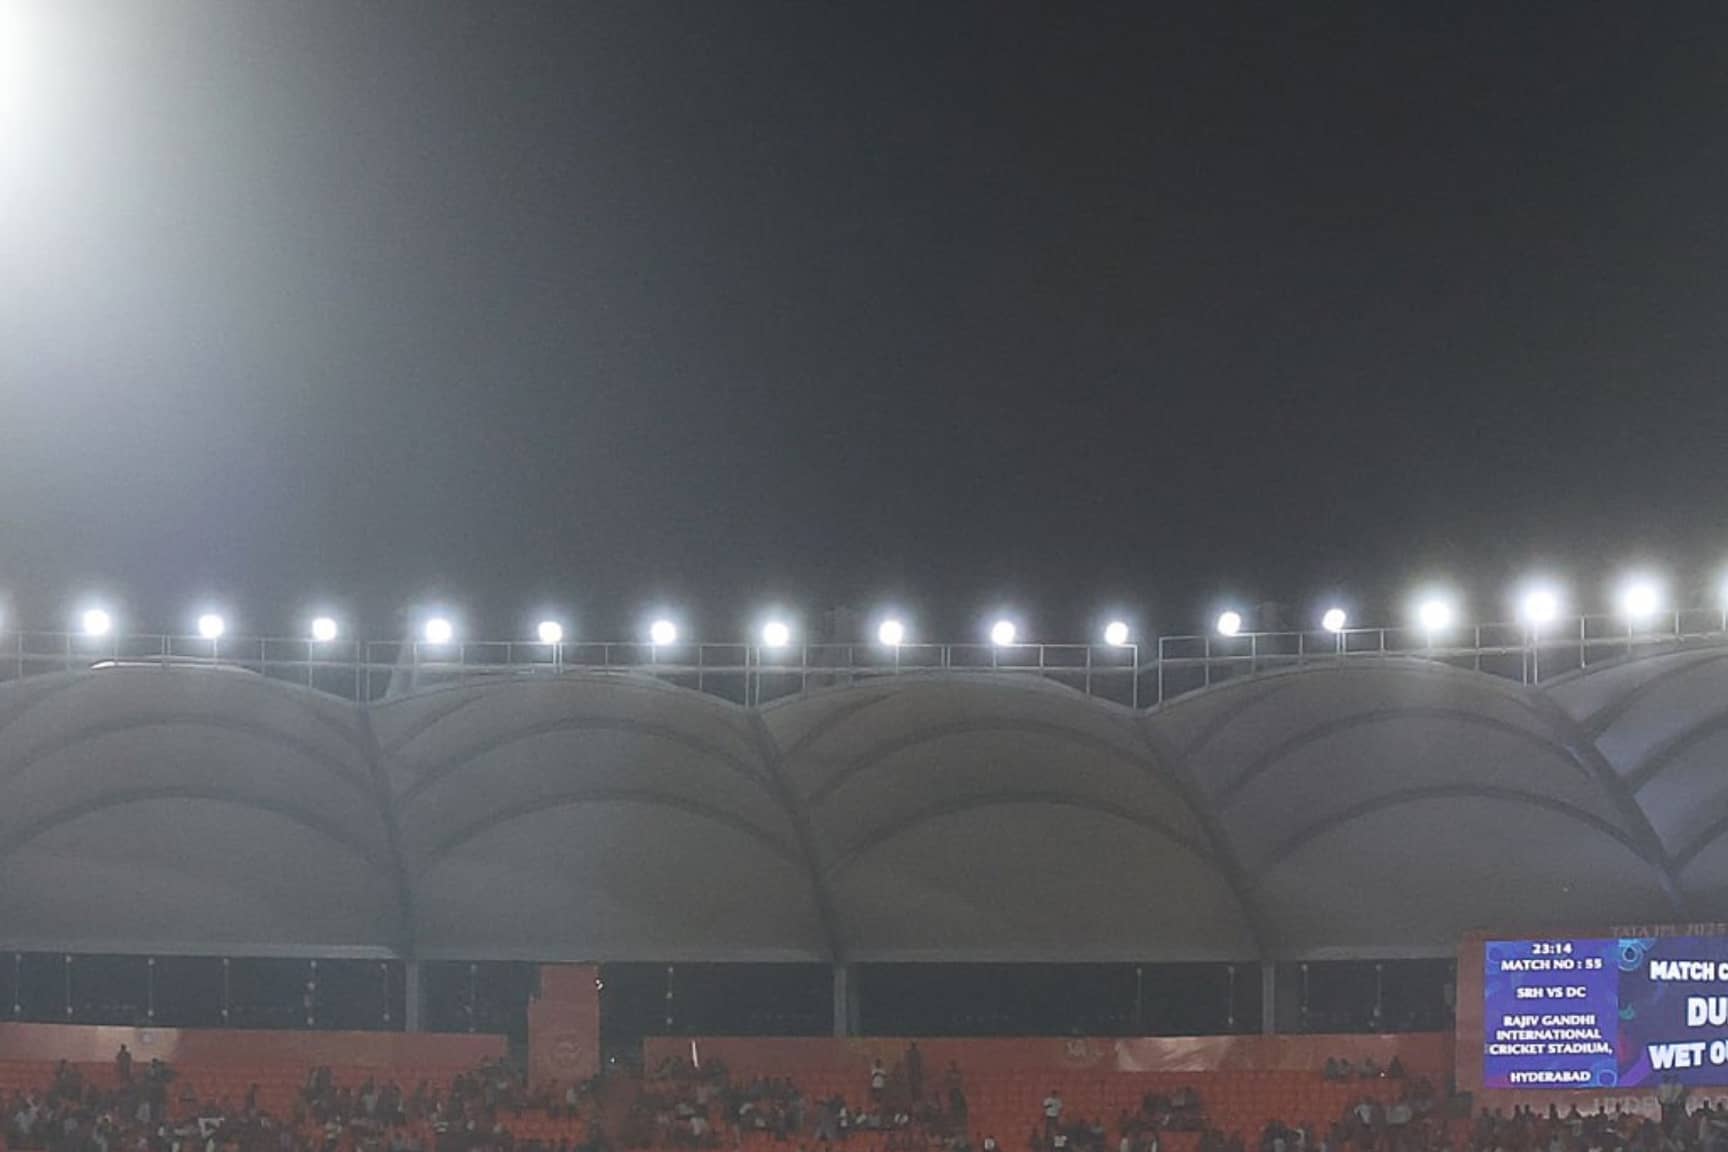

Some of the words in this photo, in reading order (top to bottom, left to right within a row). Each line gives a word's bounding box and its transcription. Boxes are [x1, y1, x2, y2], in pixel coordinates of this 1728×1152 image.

[1532, 943, 1572, 955] 23:14
[1501, 959, 1550, 971] MATCH
[1553, 959, 1575, 970] NO
[1585, 958, 1603, 970] 55
[1649, 960, 1715, 981] MATCH
[1516, 987, 1543, 999] SRH
[1546, 987, 1563, 998] VS
[1566, 987, 1586, 998] DC
[1503, 1015, 1539, 1028] RAJIV
[1541, 1014, 1596, 1026] GANDHI
[1496, 1029, 1602, 1041] INTERNATIONAL
[1489, 1043, 1545, 1055] CRICKET
[1548, 1043, 1613, 1056] STADIUM,
[1648, 1042, 1706, 1070] WET
[1510, 1070, 1592, 1083] HYDERABAD
